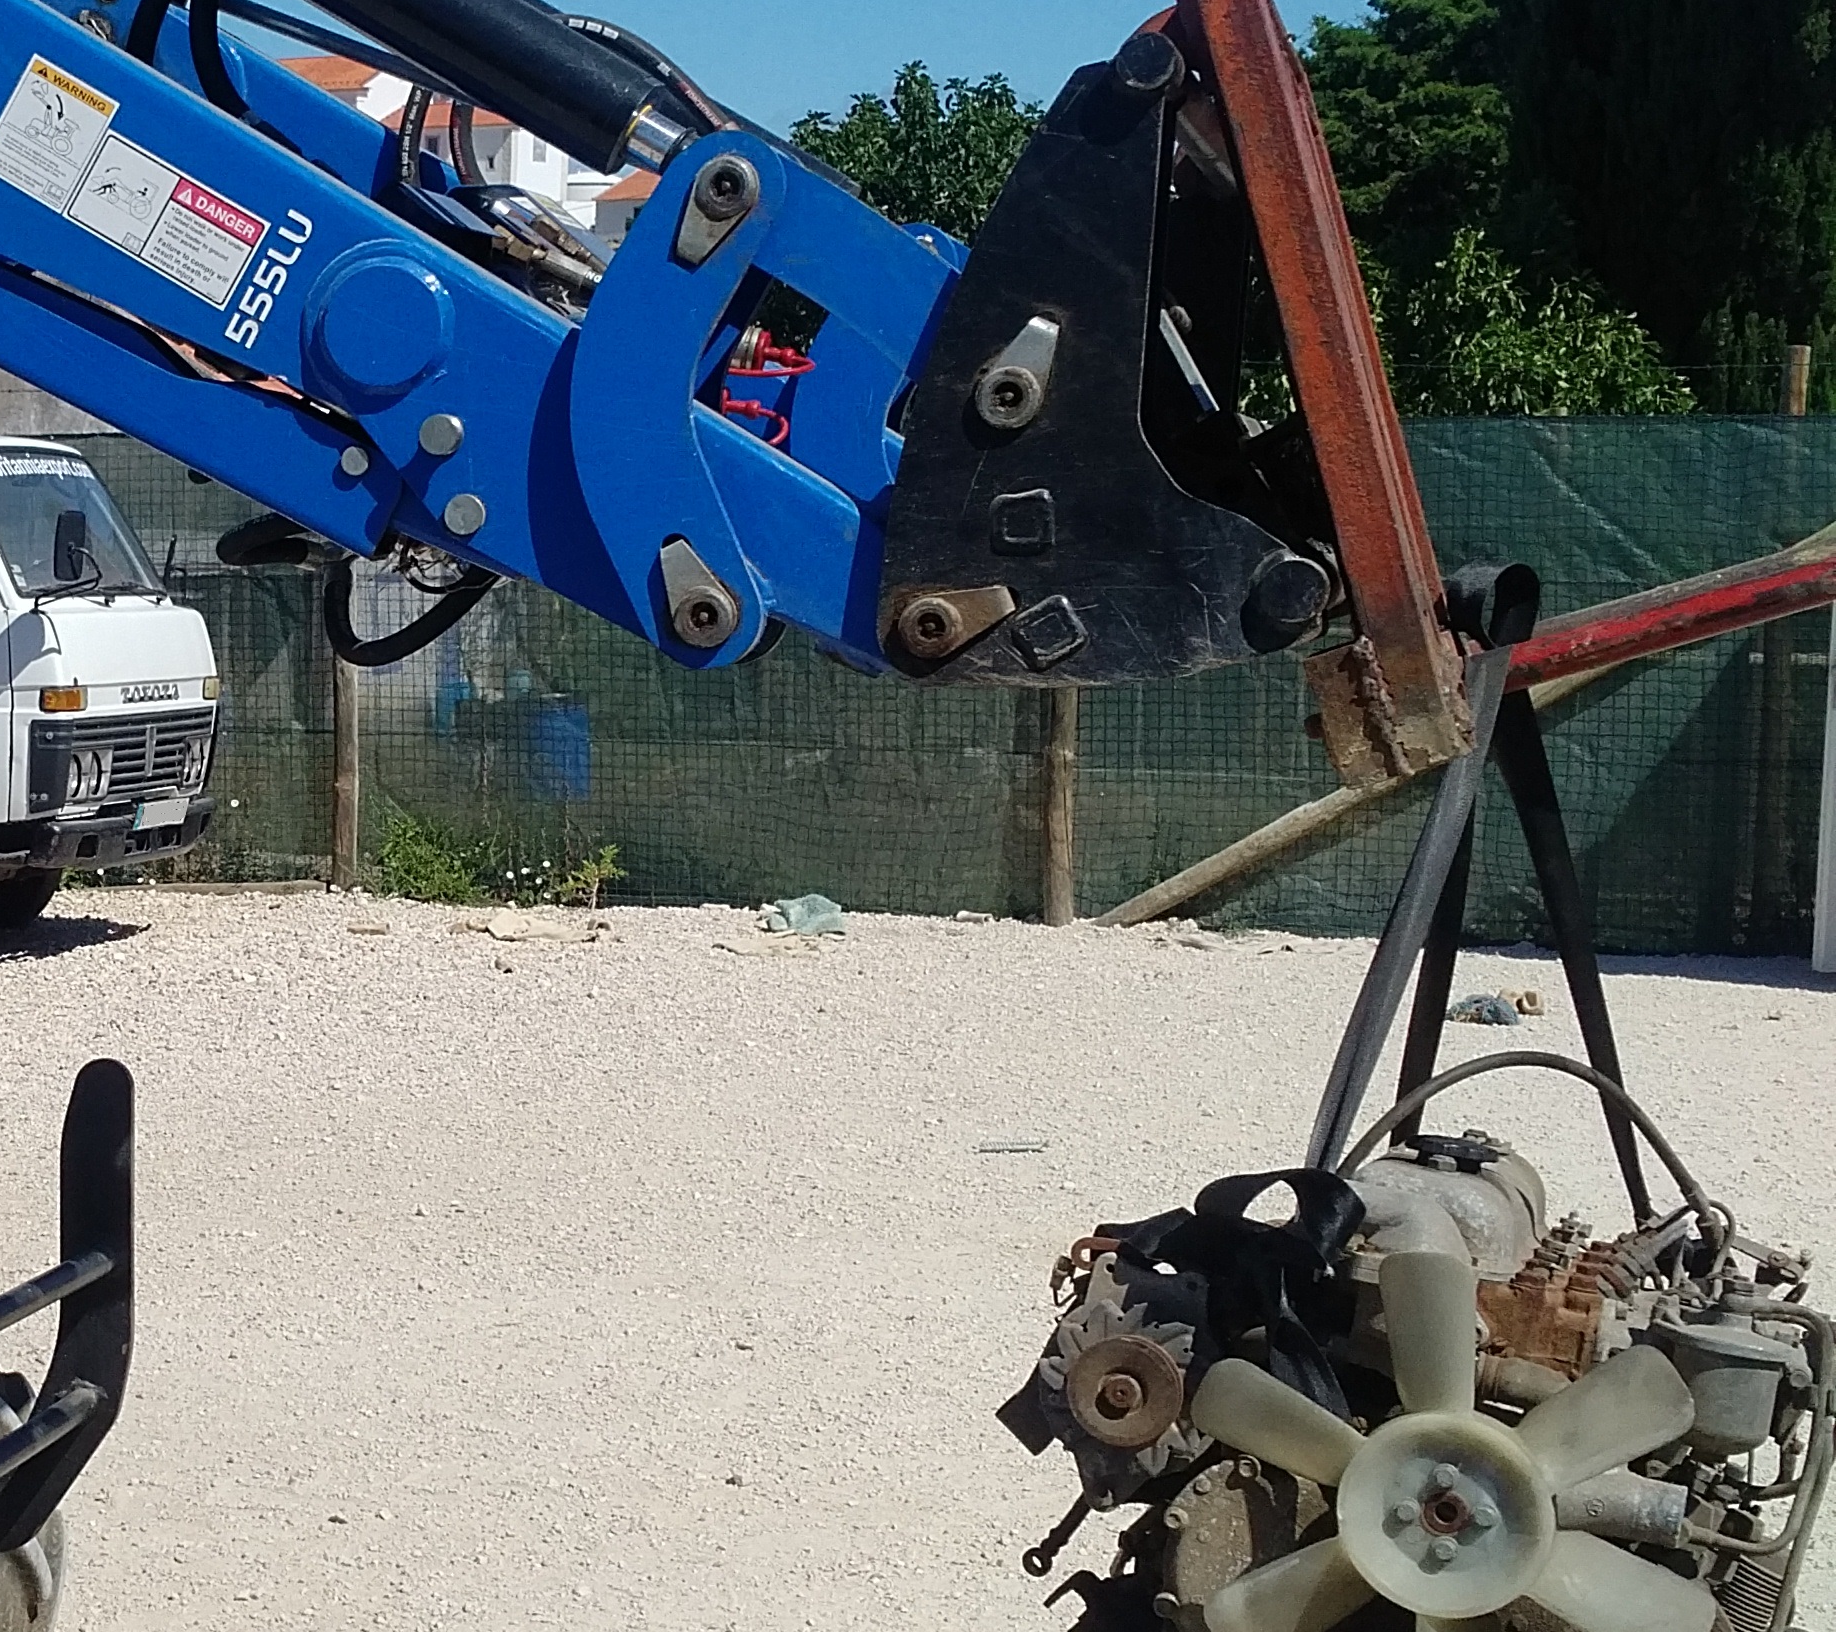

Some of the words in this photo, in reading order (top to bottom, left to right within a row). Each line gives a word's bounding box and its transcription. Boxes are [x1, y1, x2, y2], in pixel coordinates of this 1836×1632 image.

[53, 74, 106, 111] WARNING
[194, 195, 255, 238] DANGER
[157, 237, 181, 255] Failure
[190, 258, 215, 276] comply
[181, 263, 201, 277] death
[224, 209, 312, 349] 555LU
[121, 684, 180, 703] TOYOTA
